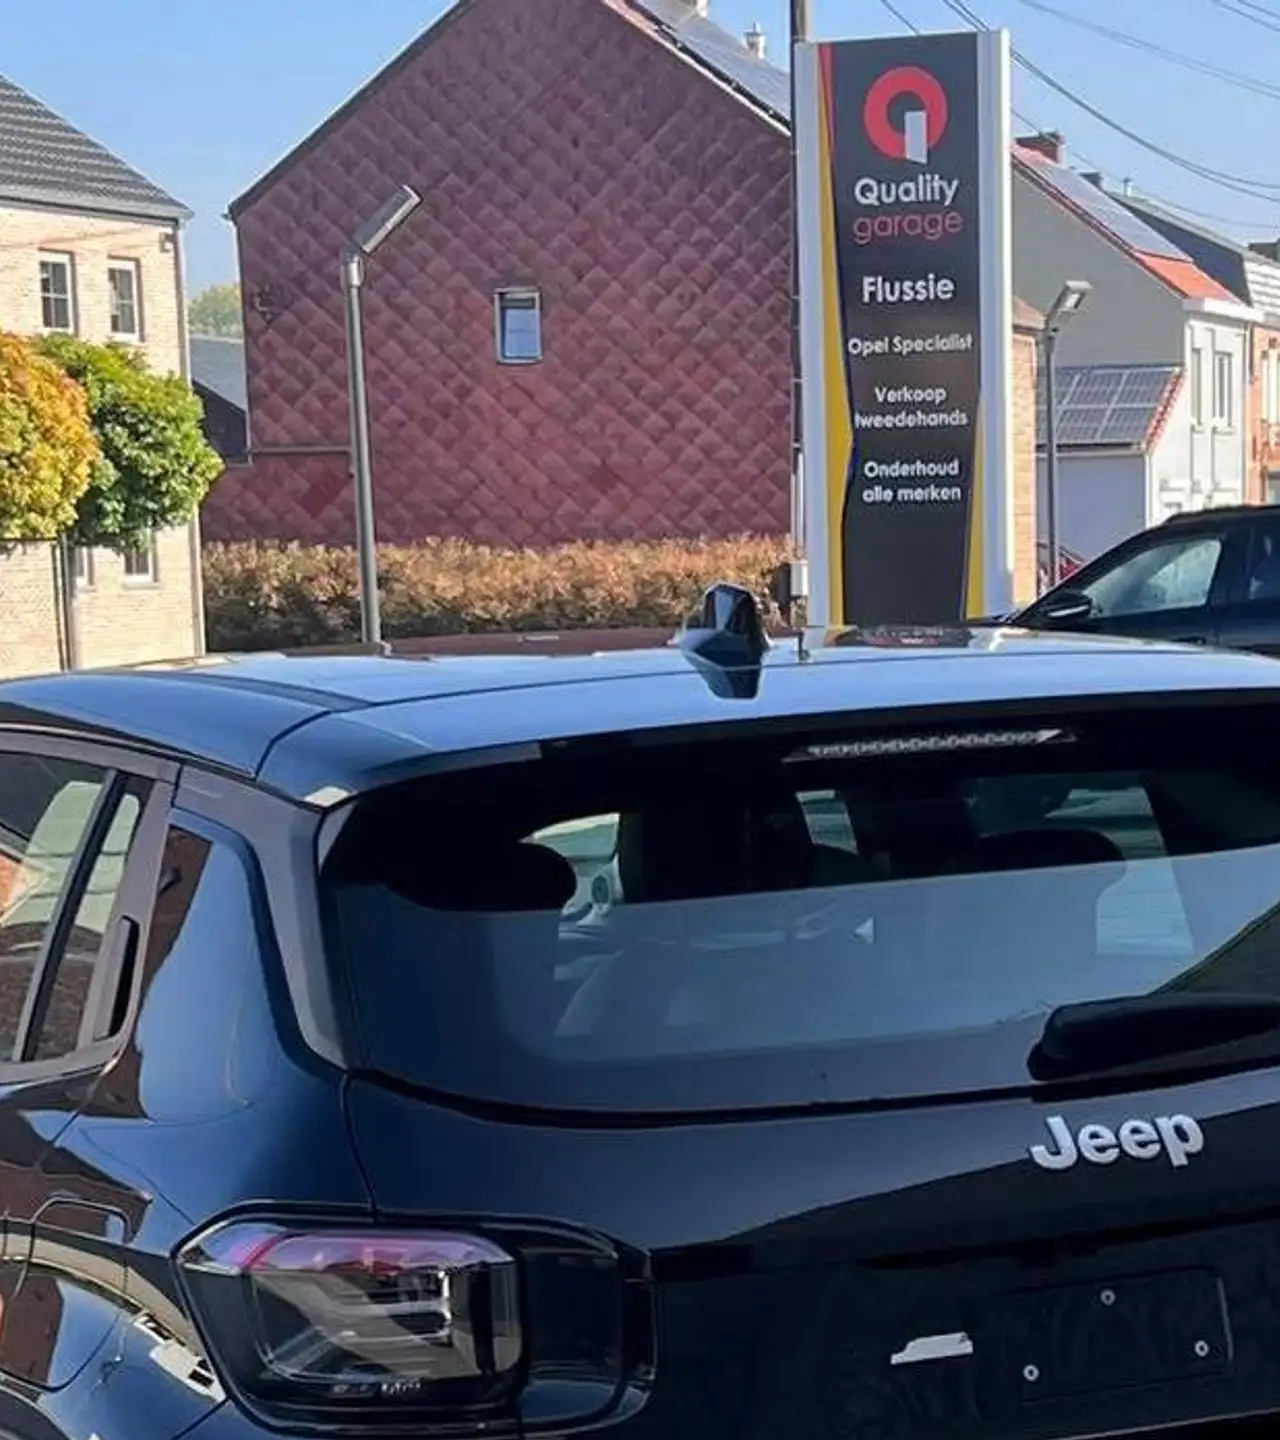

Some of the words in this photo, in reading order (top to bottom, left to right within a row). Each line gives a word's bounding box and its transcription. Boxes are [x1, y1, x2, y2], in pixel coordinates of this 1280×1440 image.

[854, 173, 959, 206] Quality
[852, 210, 964, 245] garage
[861, 273, 955, 304] Flussie
[847, 337, 889, 357] Opel
[892, 334, 973, 357] Specialist
[874, 386, 948, 405] Verkoop
[854, 409, 969, 429] tweedehands
[863, 459, 960, 479] Onderhoud
[862, 485, 893, 504] alle
[897, 486, 962, 503] merken
[1029, 1113, 1205, 1171] Jeep
